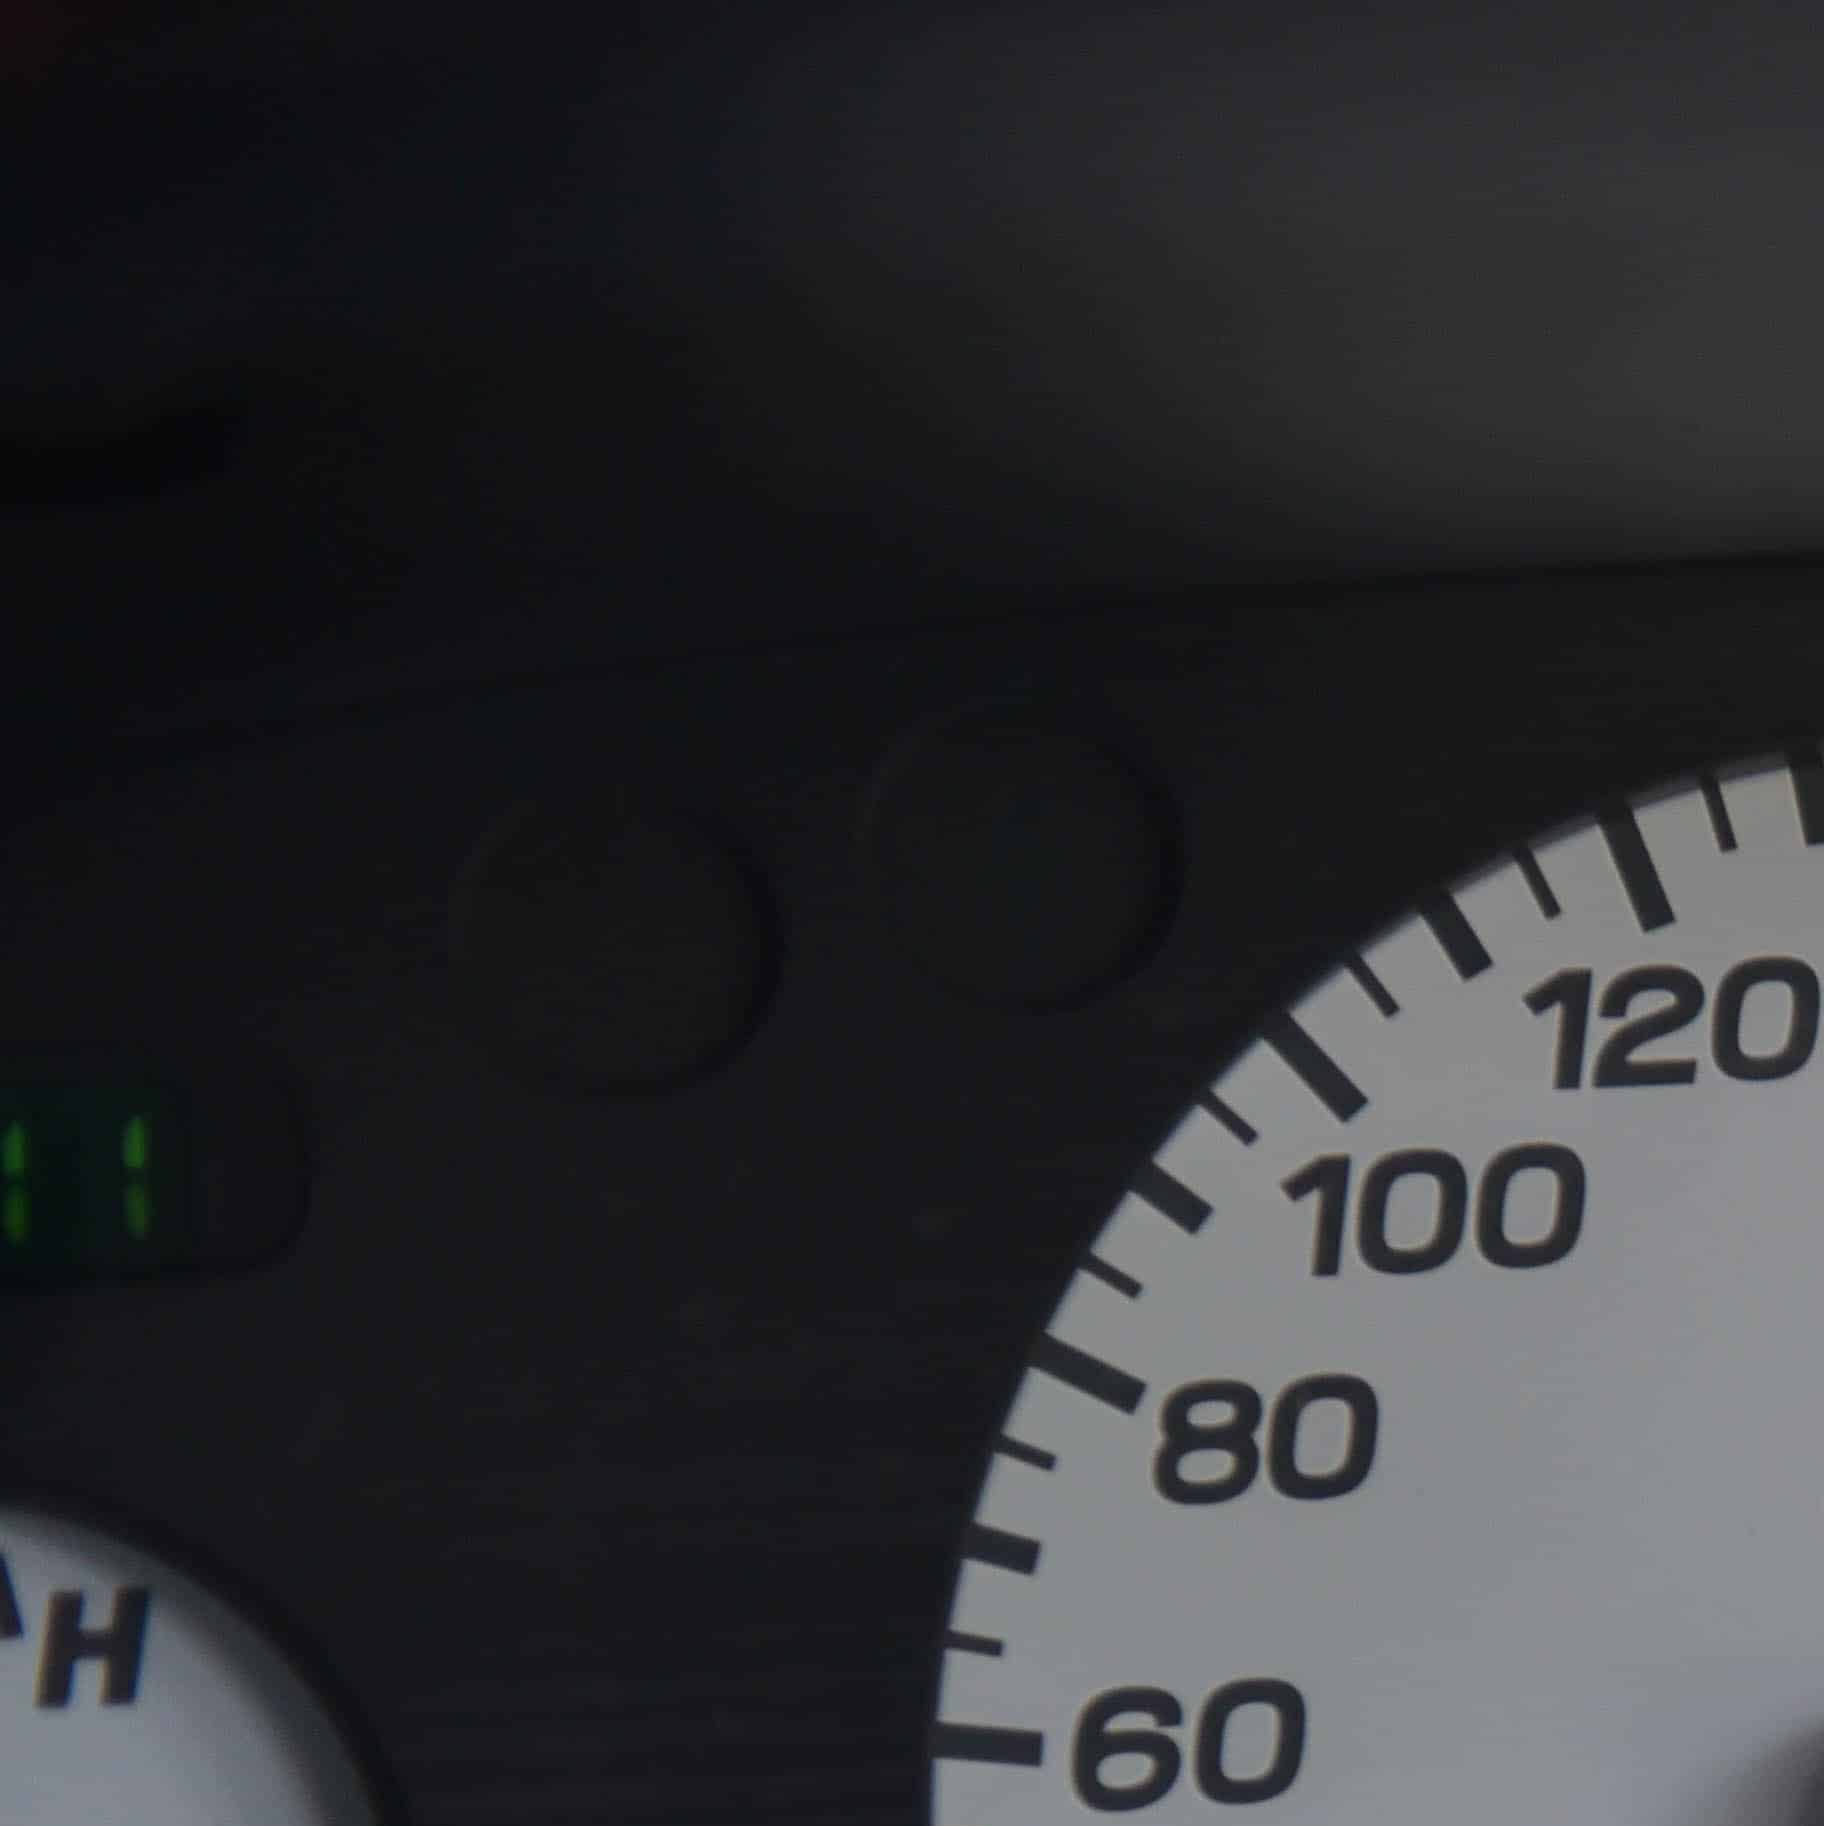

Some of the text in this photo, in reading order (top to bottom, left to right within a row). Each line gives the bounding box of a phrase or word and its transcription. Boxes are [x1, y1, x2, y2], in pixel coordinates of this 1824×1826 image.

[1524, 957, 1821, 1089] 120
[1282, 1143, 1587, 1277] 100
[1154, 1374, 1379, 1505] 80
[1072, 1678, 1307, 1814] 60
